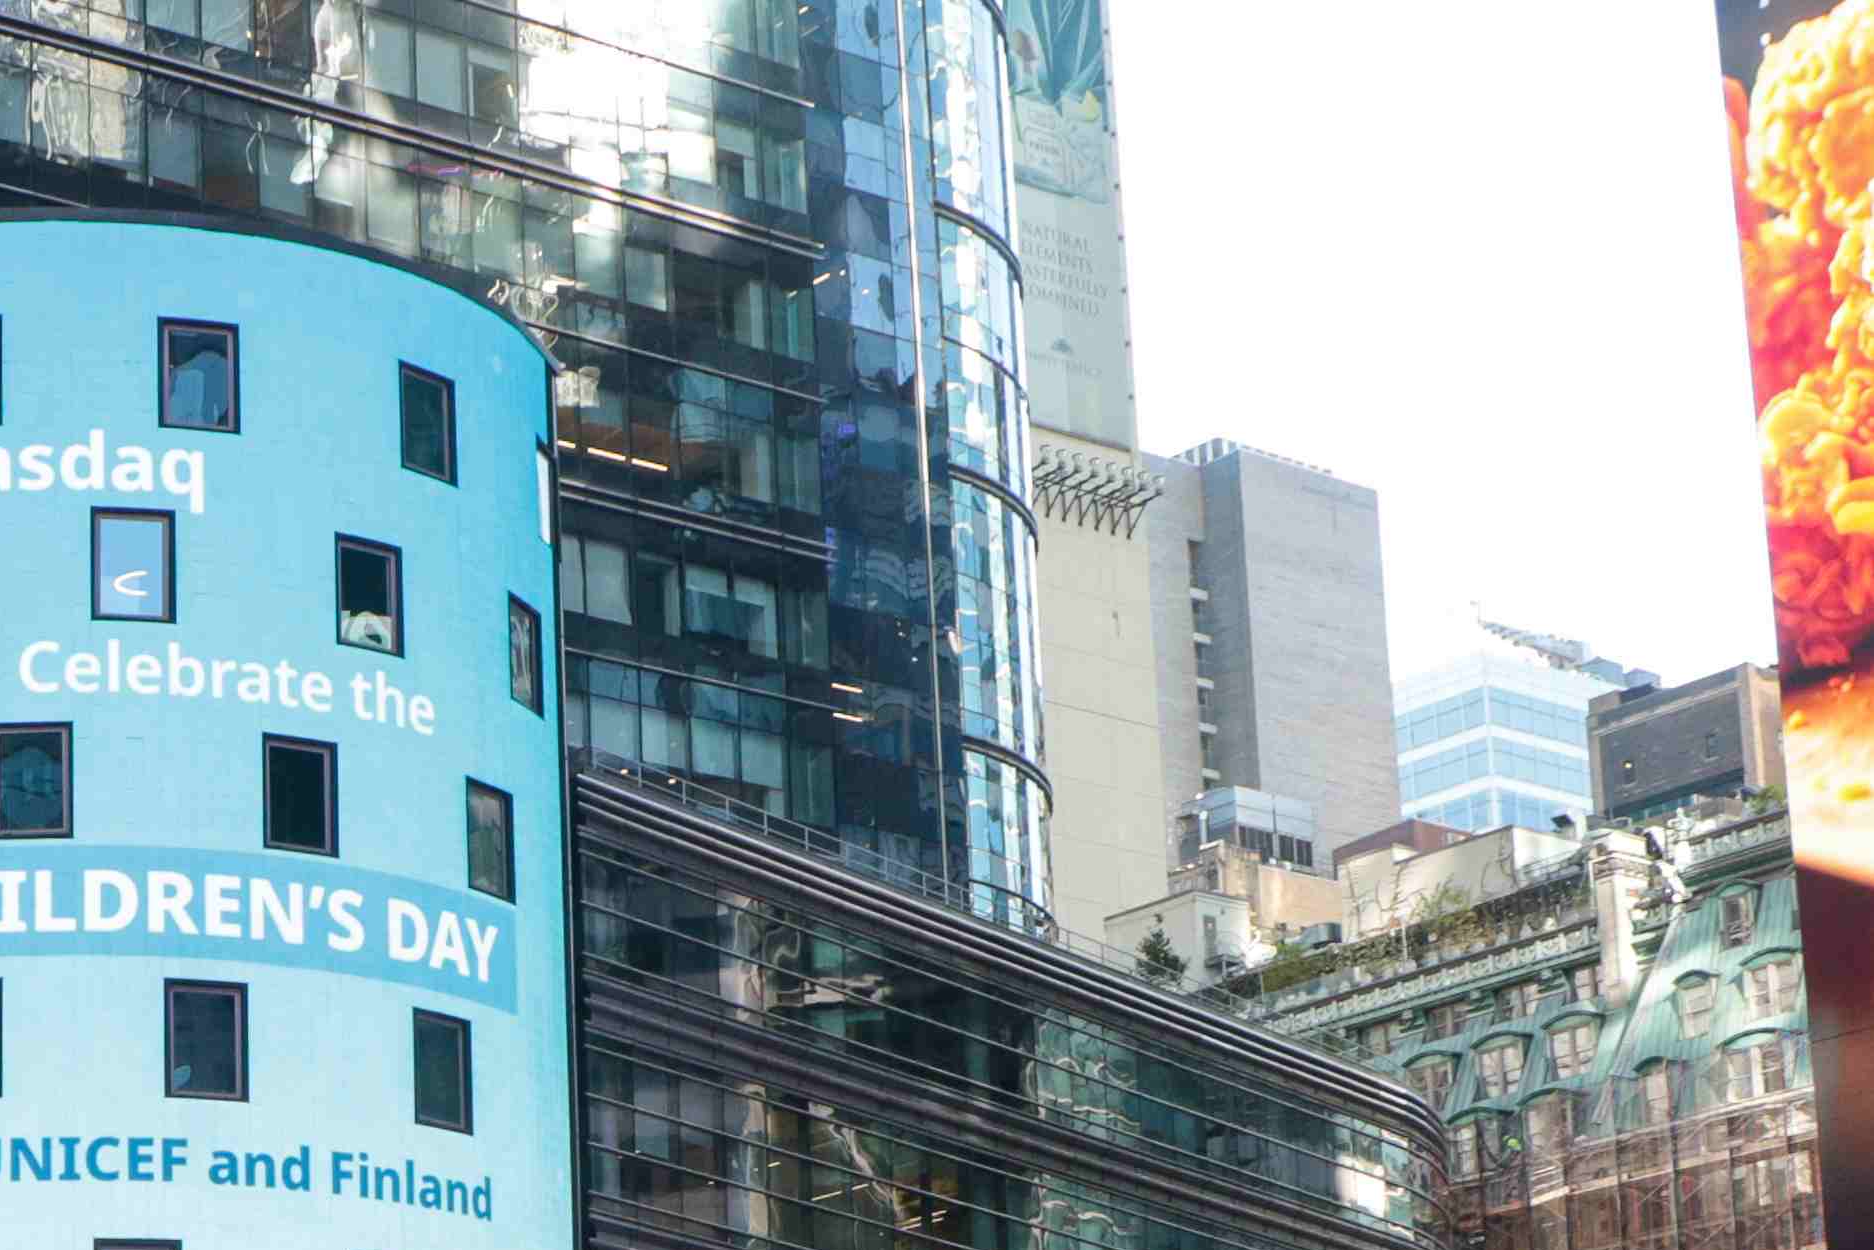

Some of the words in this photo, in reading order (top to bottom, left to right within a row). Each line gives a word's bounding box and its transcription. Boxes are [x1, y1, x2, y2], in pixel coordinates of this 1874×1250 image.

[18, 637, 332, 714] Celebrate
[351, 670, 436, 735] the
[386, 898, 500, 984] DAY
[207, 1139, 312, 1193] and
[329, 1150, 494, 1222] Finland
